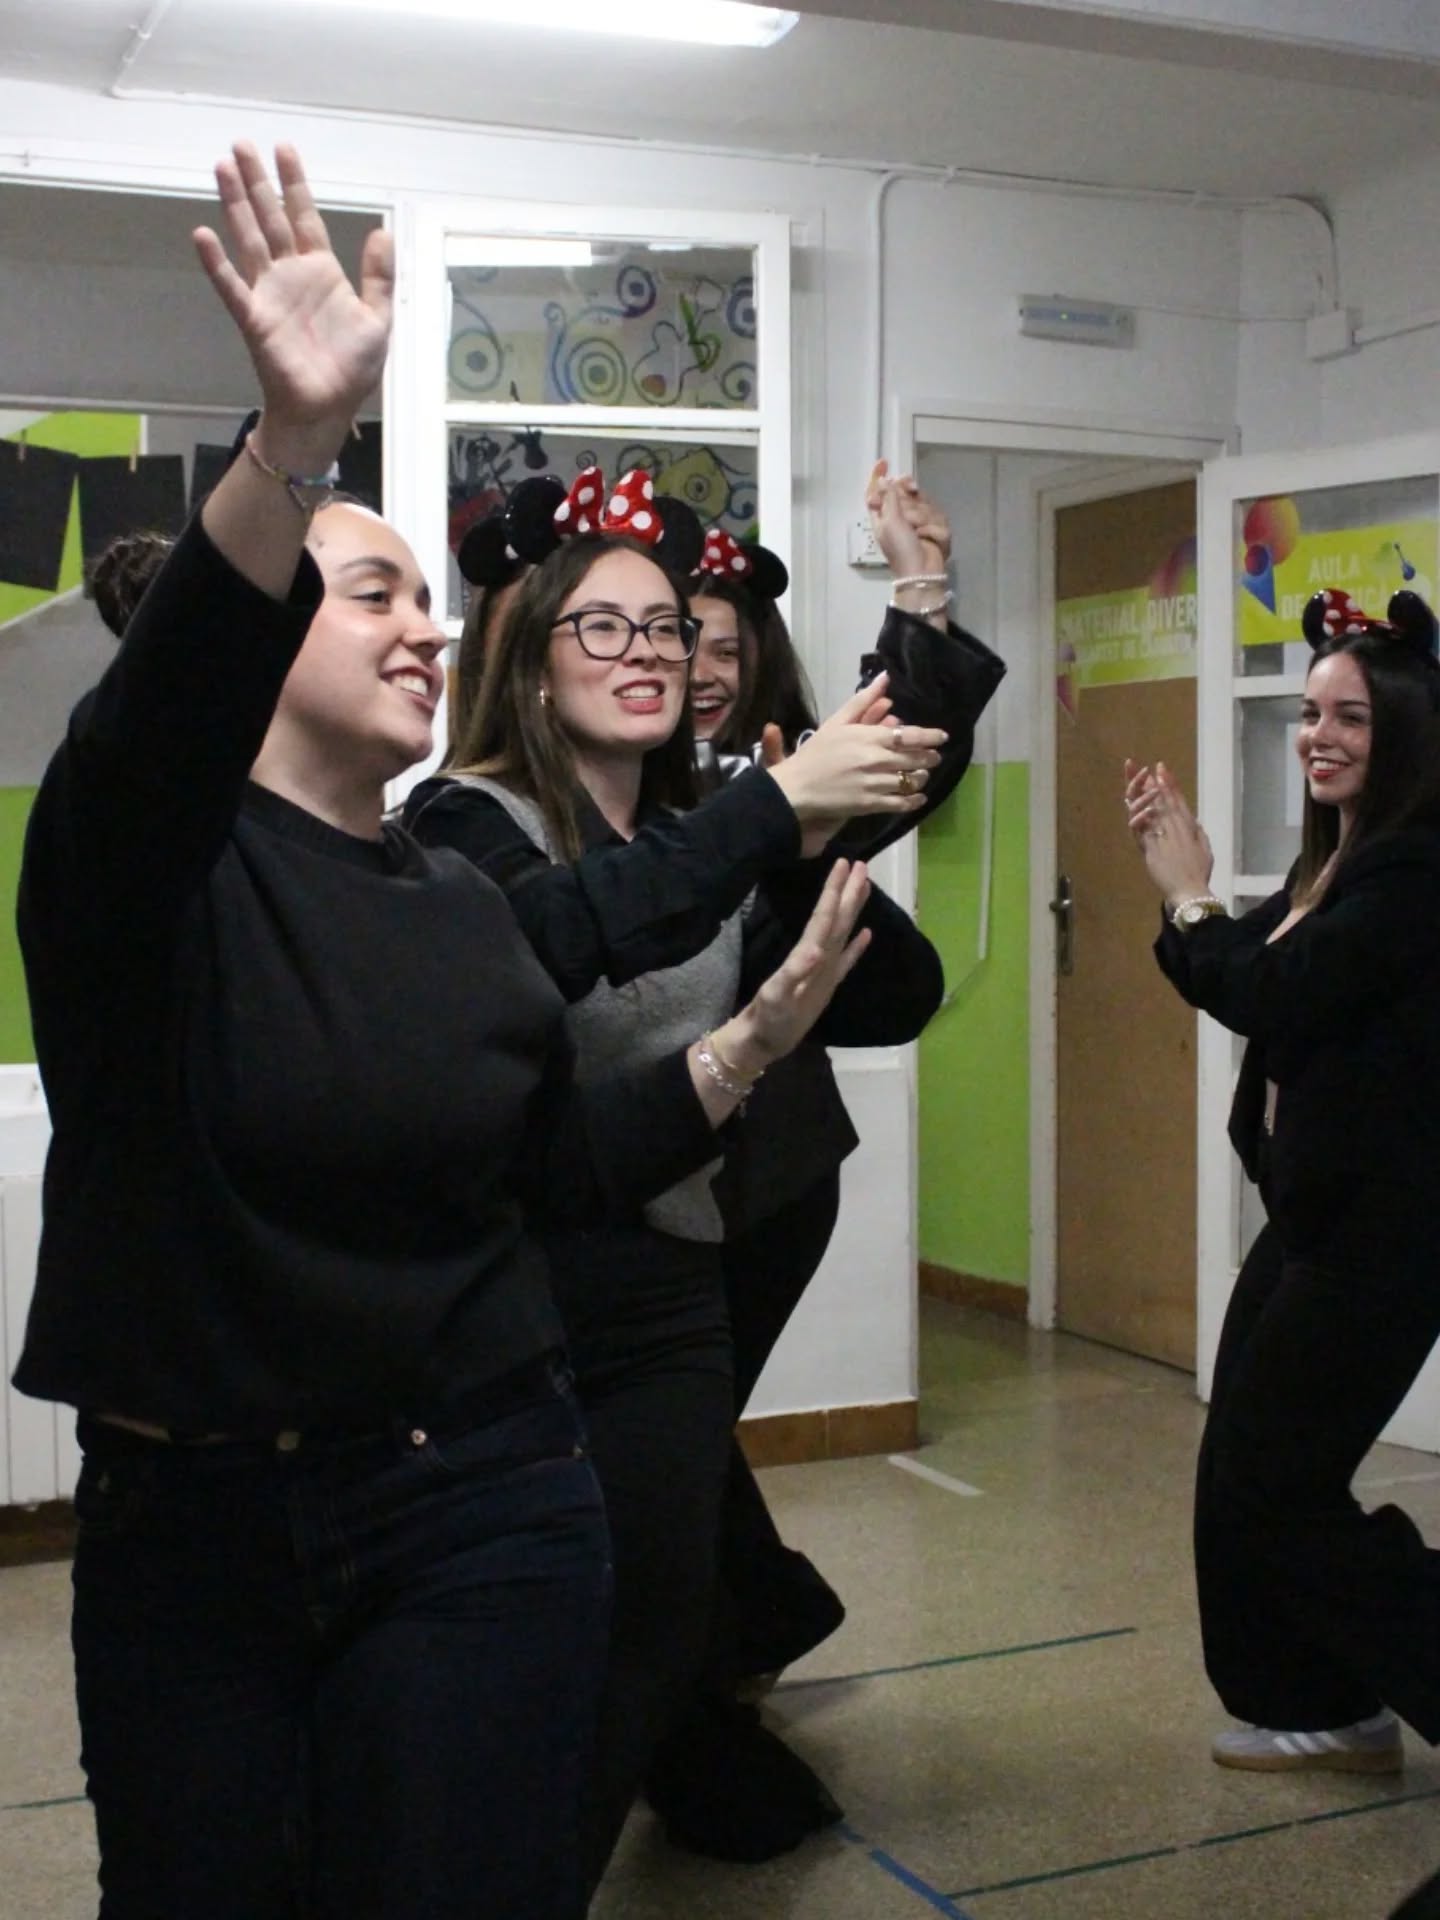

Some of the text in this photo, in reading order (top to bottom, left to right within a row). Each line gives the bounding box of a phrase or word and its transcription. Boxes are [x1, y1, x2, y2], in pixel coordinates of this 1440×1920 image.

[1307, 551, 1362, 583] AULA
[1061, 594, 1197, 643] MATERIAL DIVER
[1280, 592, 1305, 622] DE
